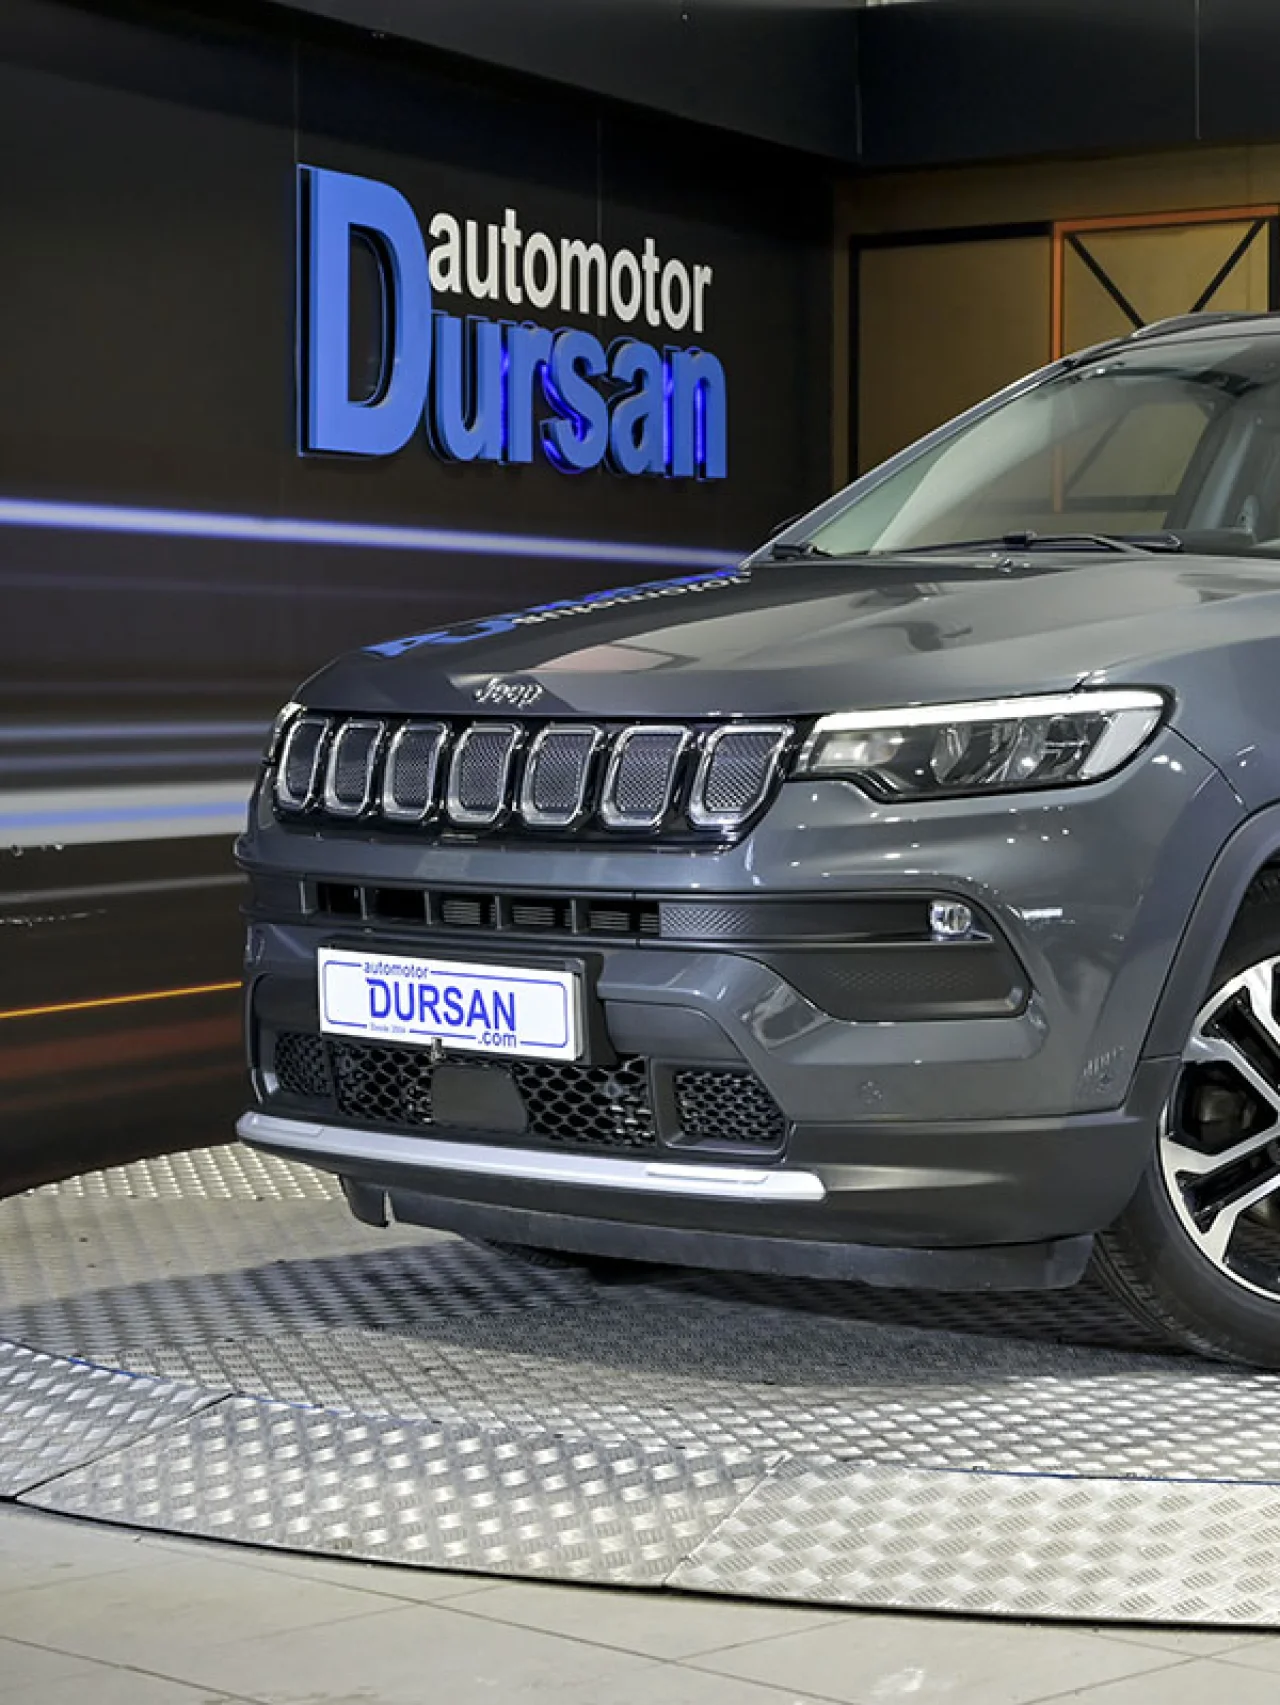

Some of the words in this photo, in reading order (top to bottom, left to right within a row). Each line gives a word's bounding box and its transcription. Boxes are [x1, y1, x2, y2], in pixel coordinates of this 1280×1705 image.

[428, 207, 712, 333] automotor
[297, 164, 727, 480] Dursan
[476, 678, 543, 709] Jeep
[363, 961, 429, 979] automotor
[366, 978, 516, 1031] DURSAN
[477, 1031, 517, 1048] .com
